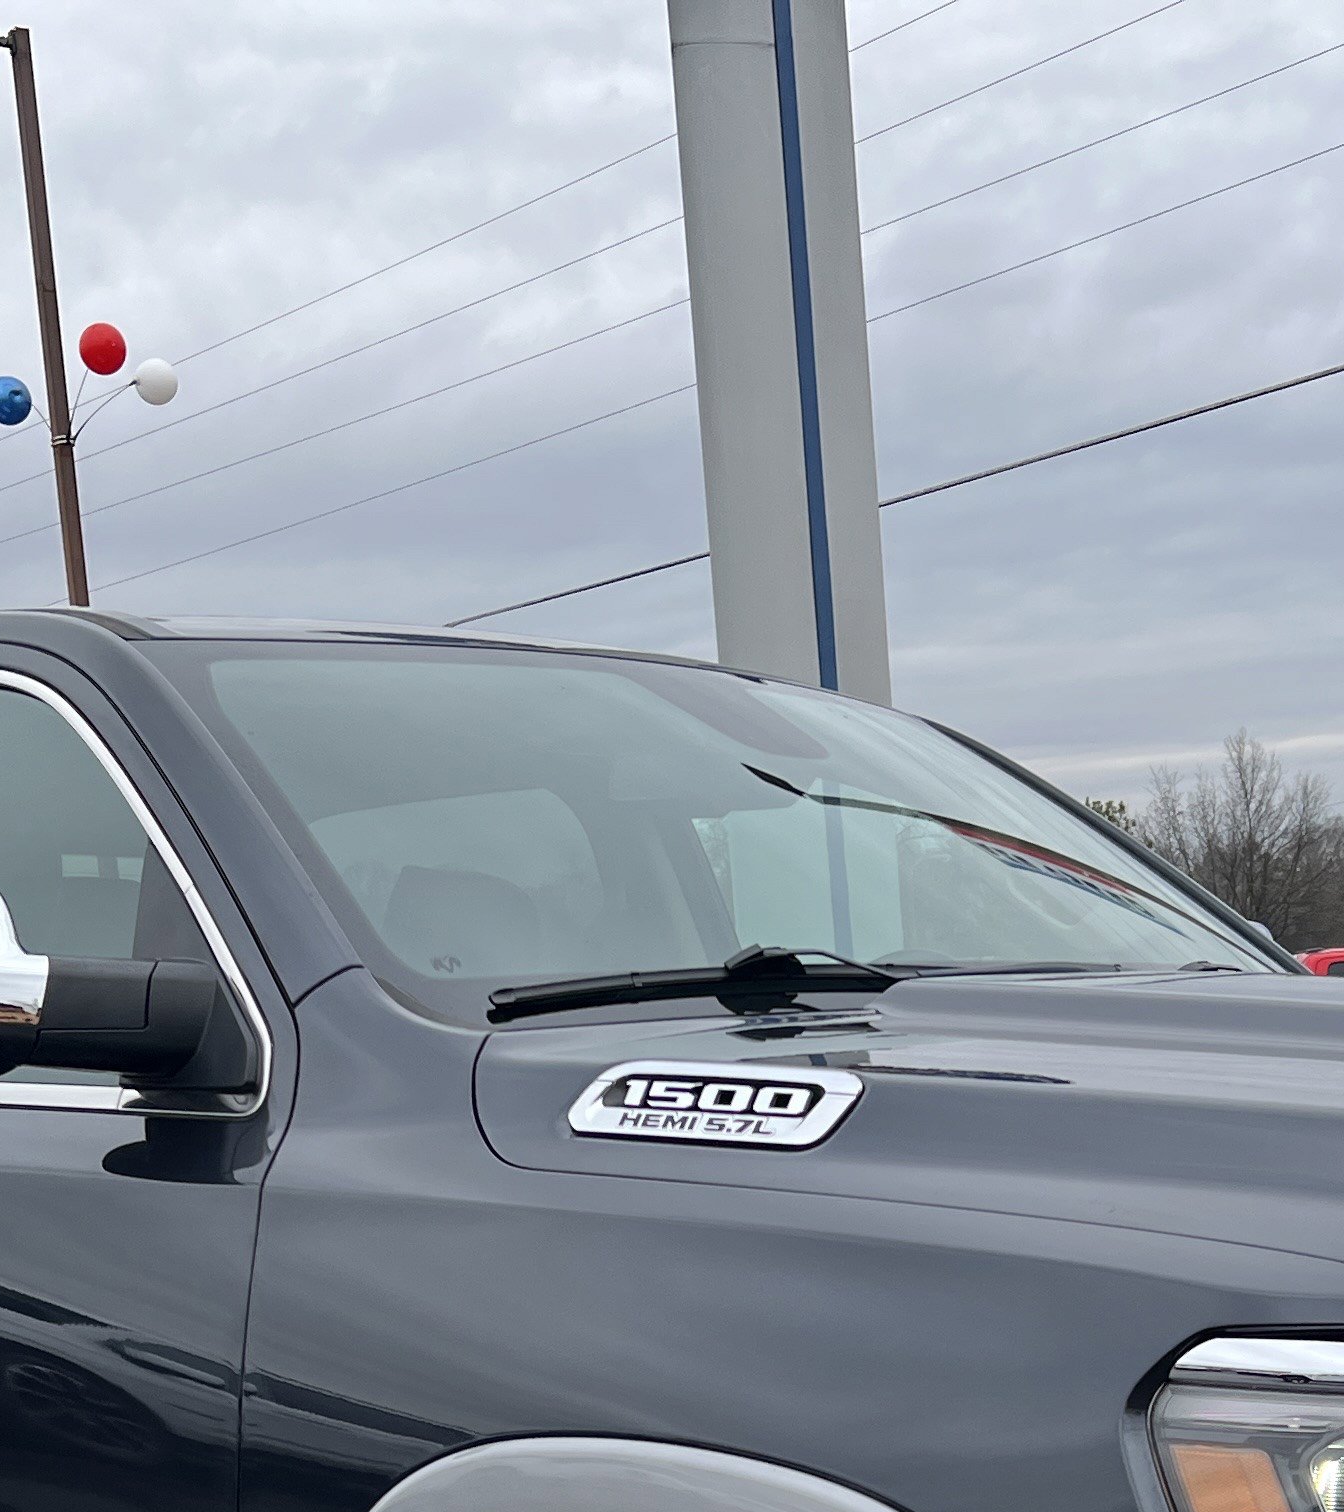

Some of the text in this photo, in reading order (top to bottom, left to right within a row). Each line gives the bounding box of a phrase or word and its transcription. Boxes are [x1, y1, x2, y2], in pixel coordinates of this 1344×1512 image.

[623, 1079, 812, 1116] 1500
[619, 1112, 777, 1136] HEMI 5.7L
